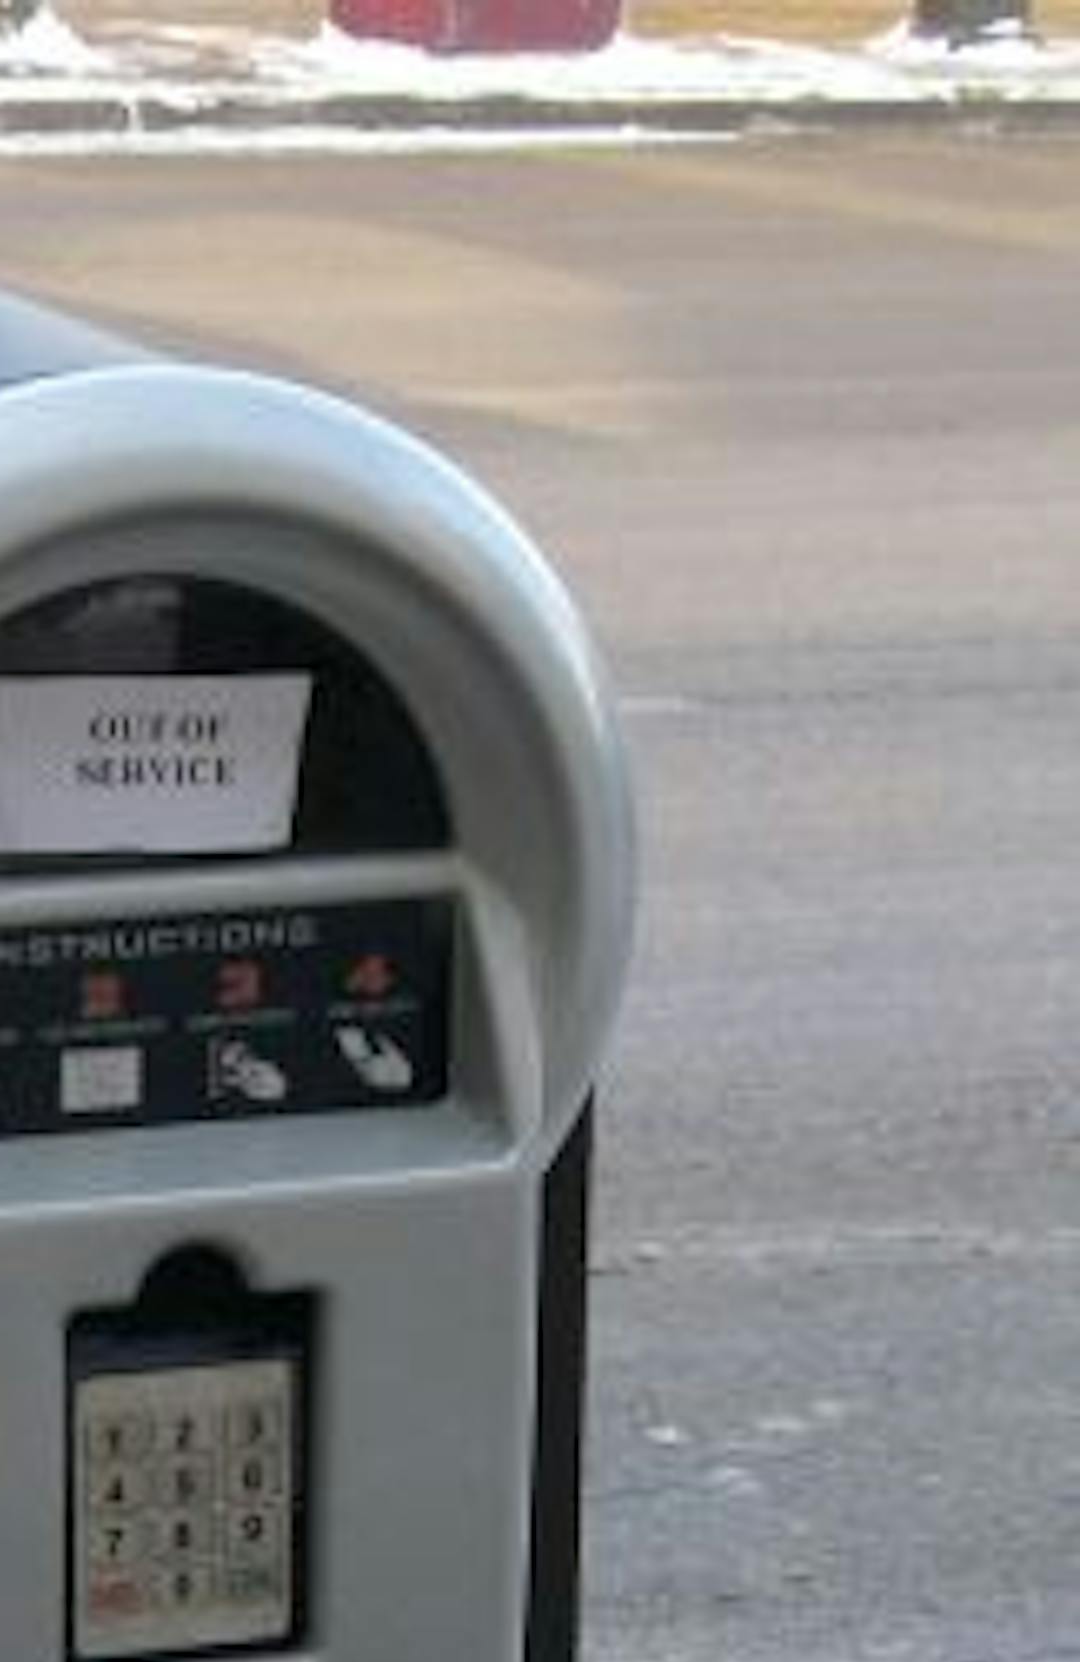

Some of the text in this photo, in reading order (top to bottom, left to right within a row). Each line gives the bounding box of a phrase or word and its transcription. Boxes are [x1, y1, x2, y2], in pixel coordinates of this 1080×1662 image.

[88, 711, 228, 743] OUT OF
[74, 755, 237, 788] SERVICE
[241, 1513, 265, 1544] 9
